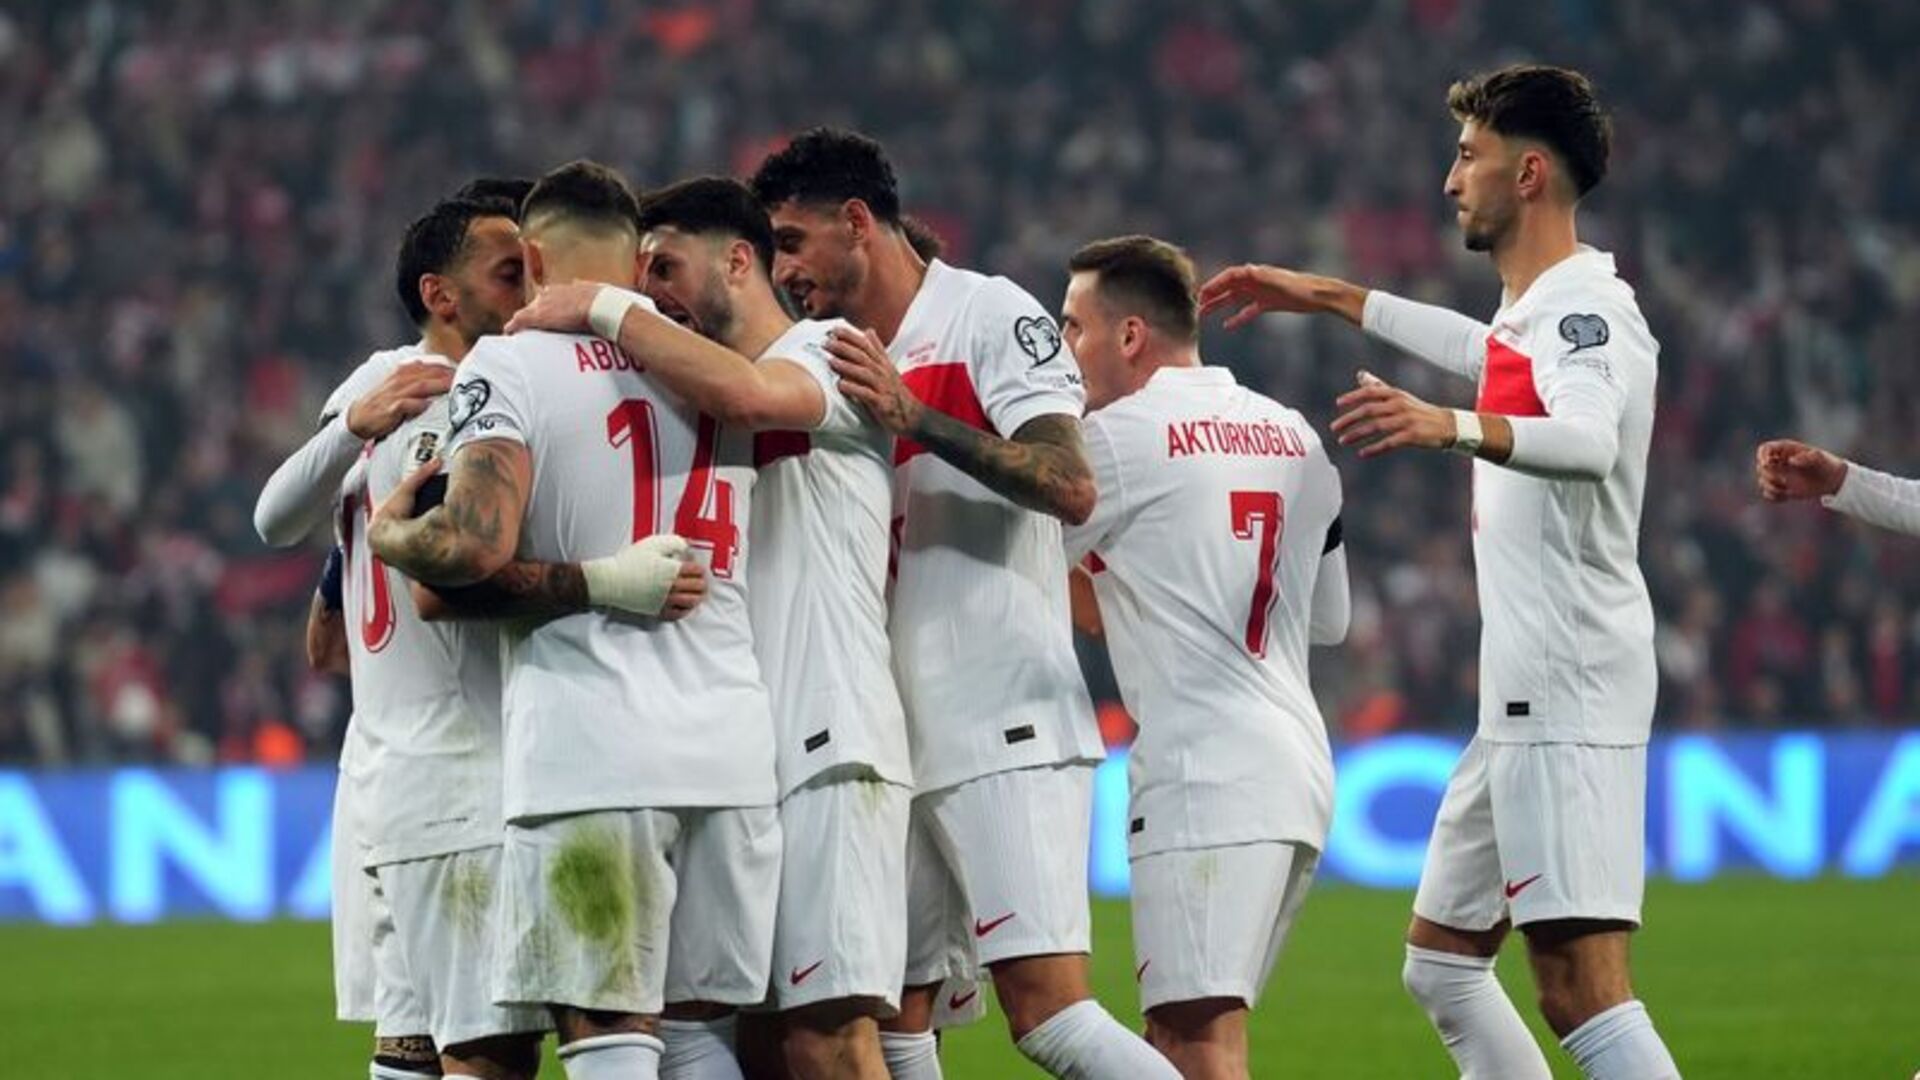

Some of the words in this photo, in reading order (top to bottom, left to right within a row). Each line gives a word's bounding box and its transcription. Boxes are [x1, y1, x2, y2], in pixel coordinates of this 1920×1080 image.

[606, 397, 741, 579] 14
[1167, 414, 1306, 458] AKTÜRKOĞLU
[1229, 490, 1285, 661] 7
